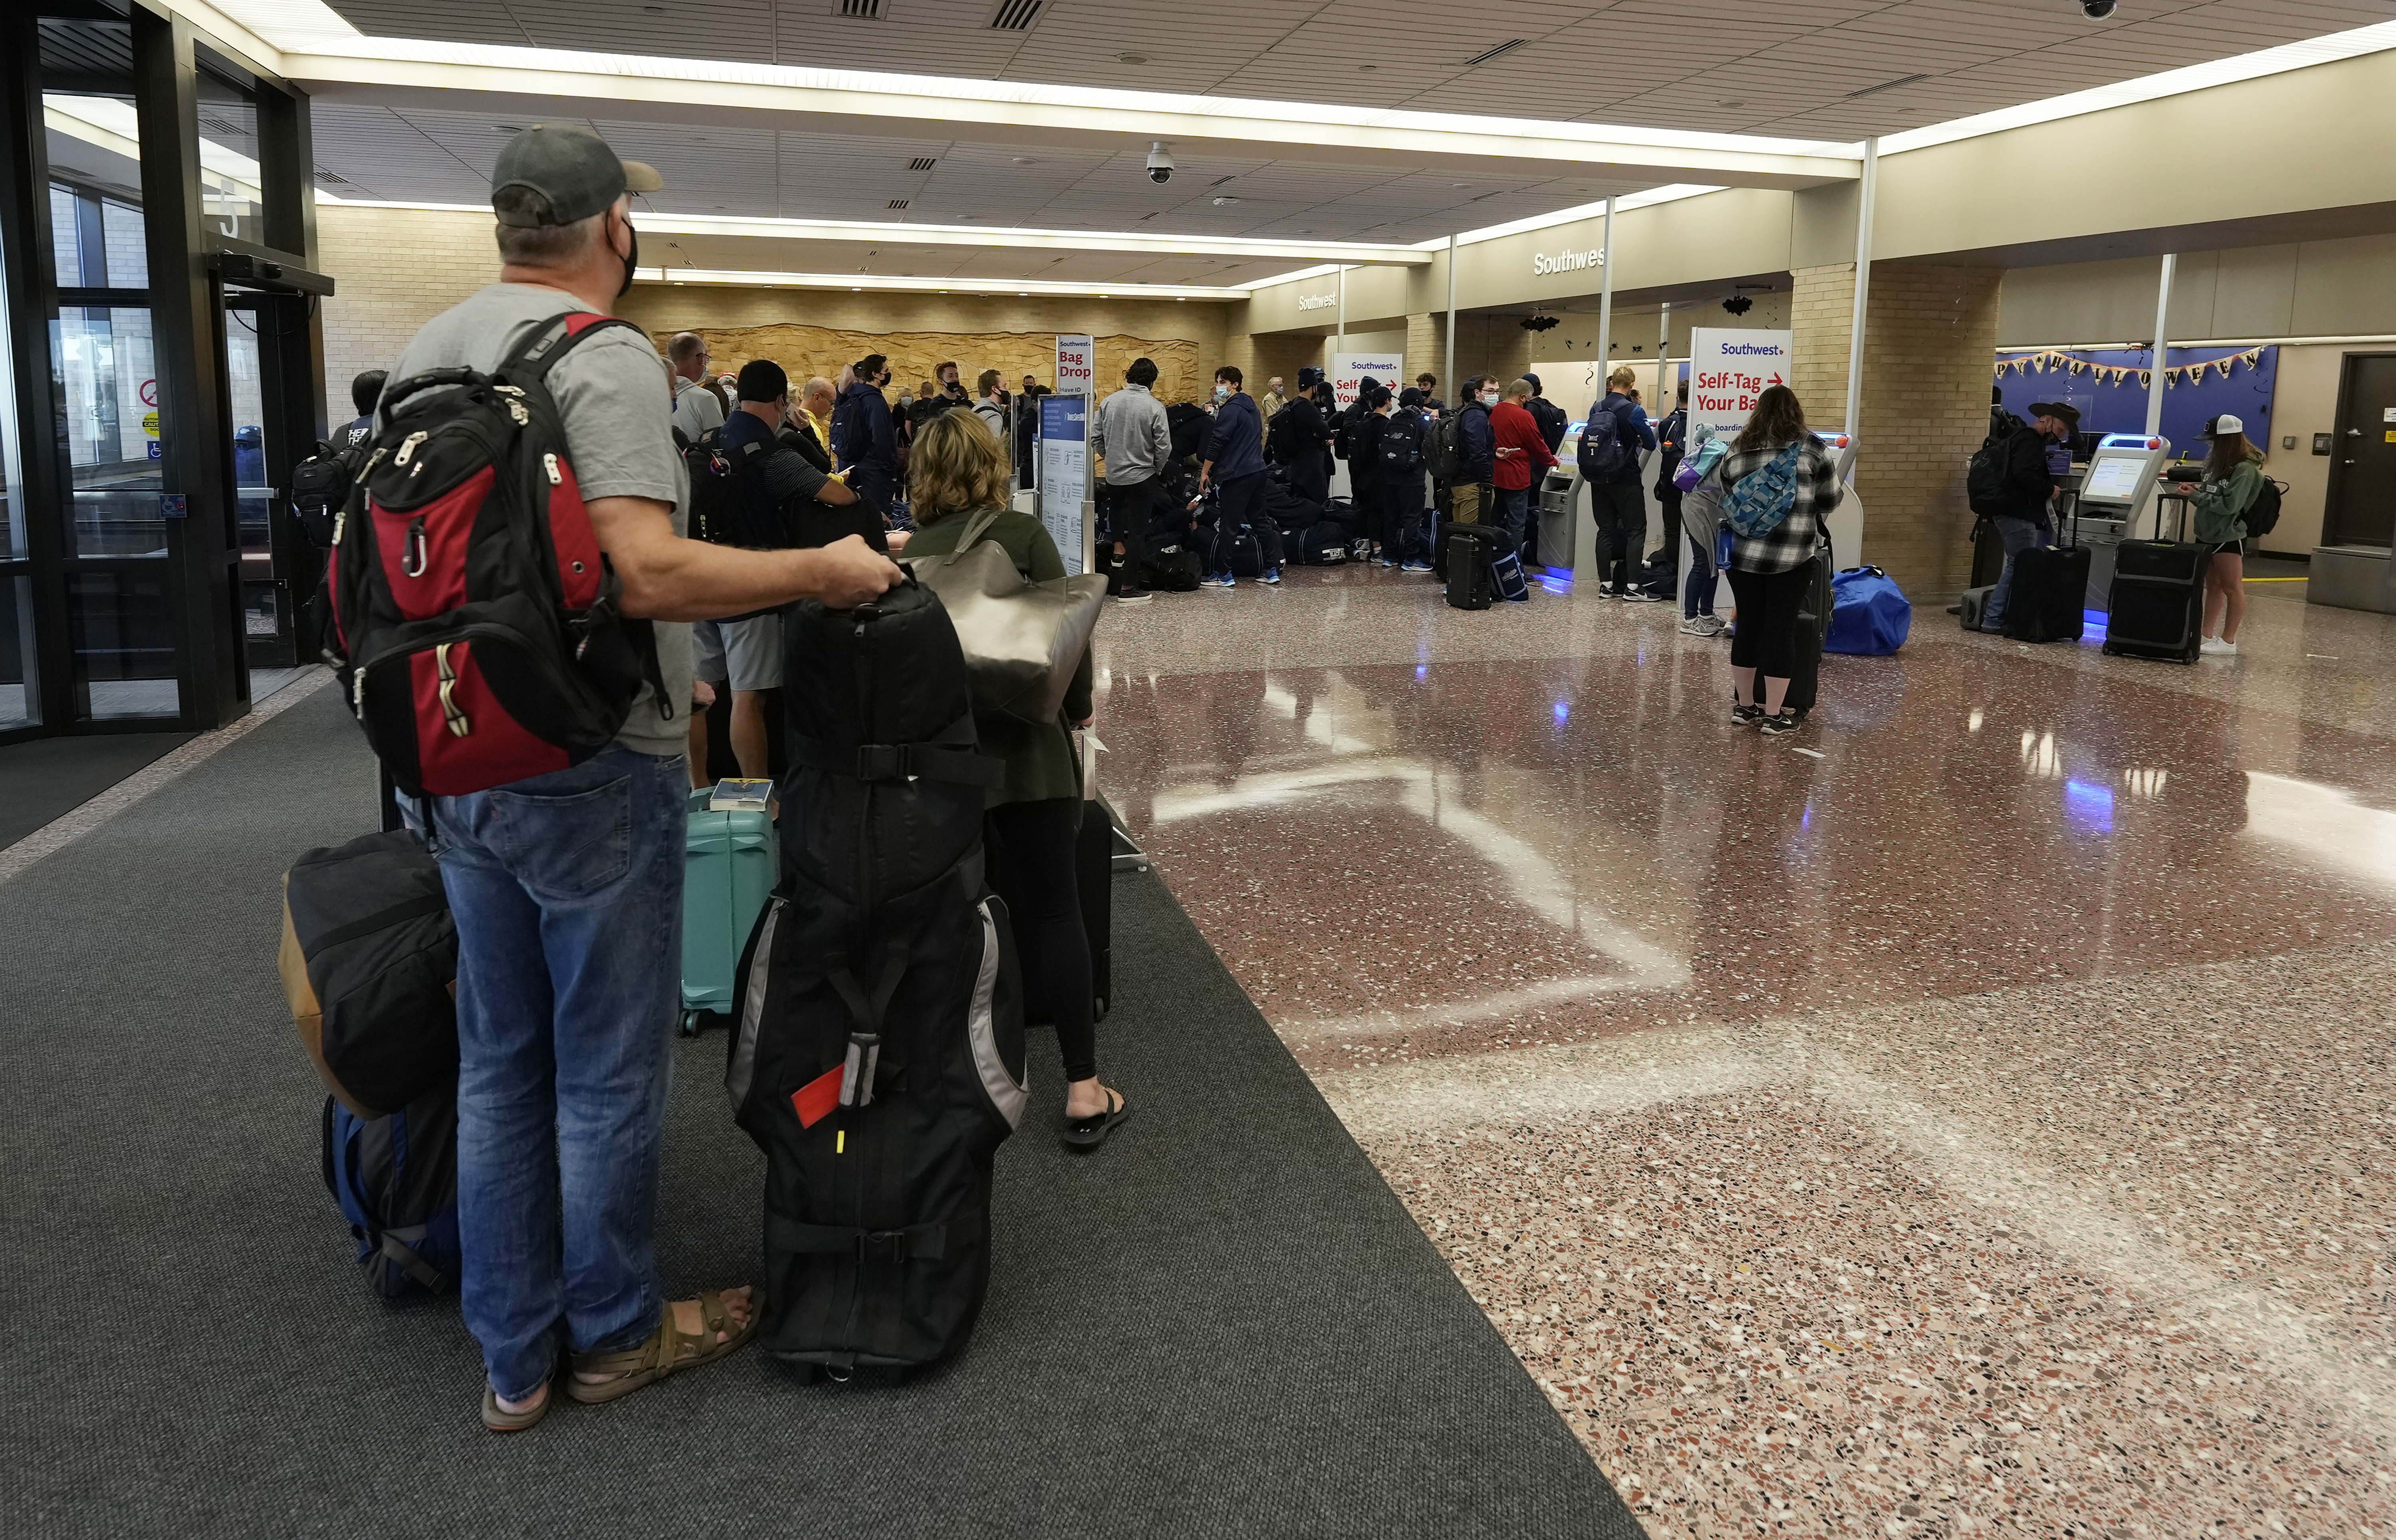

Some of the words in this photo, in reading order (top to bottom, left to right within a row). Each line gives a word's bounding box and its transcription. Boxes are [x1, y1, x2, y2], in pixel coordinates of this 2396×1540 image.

[220, 179, 239, 239] 5
[1534, 248, 1605, 275] Southwes
[1299, 291, 1336, 311] Southwest
[1722, 343, 1779, 355] Southwest
[1060, 352, 1083, 365] Bag
[1060, 366, 1091, 380] Drop
[1337, 379, 1361, 389] Self-
[1698, 372, 1761, 394] Self-Tag
[1337, 393, 1360, 403] You
[1697, 395, 1735, 410] Your
[1739, 395, 1759, 411] Ba
